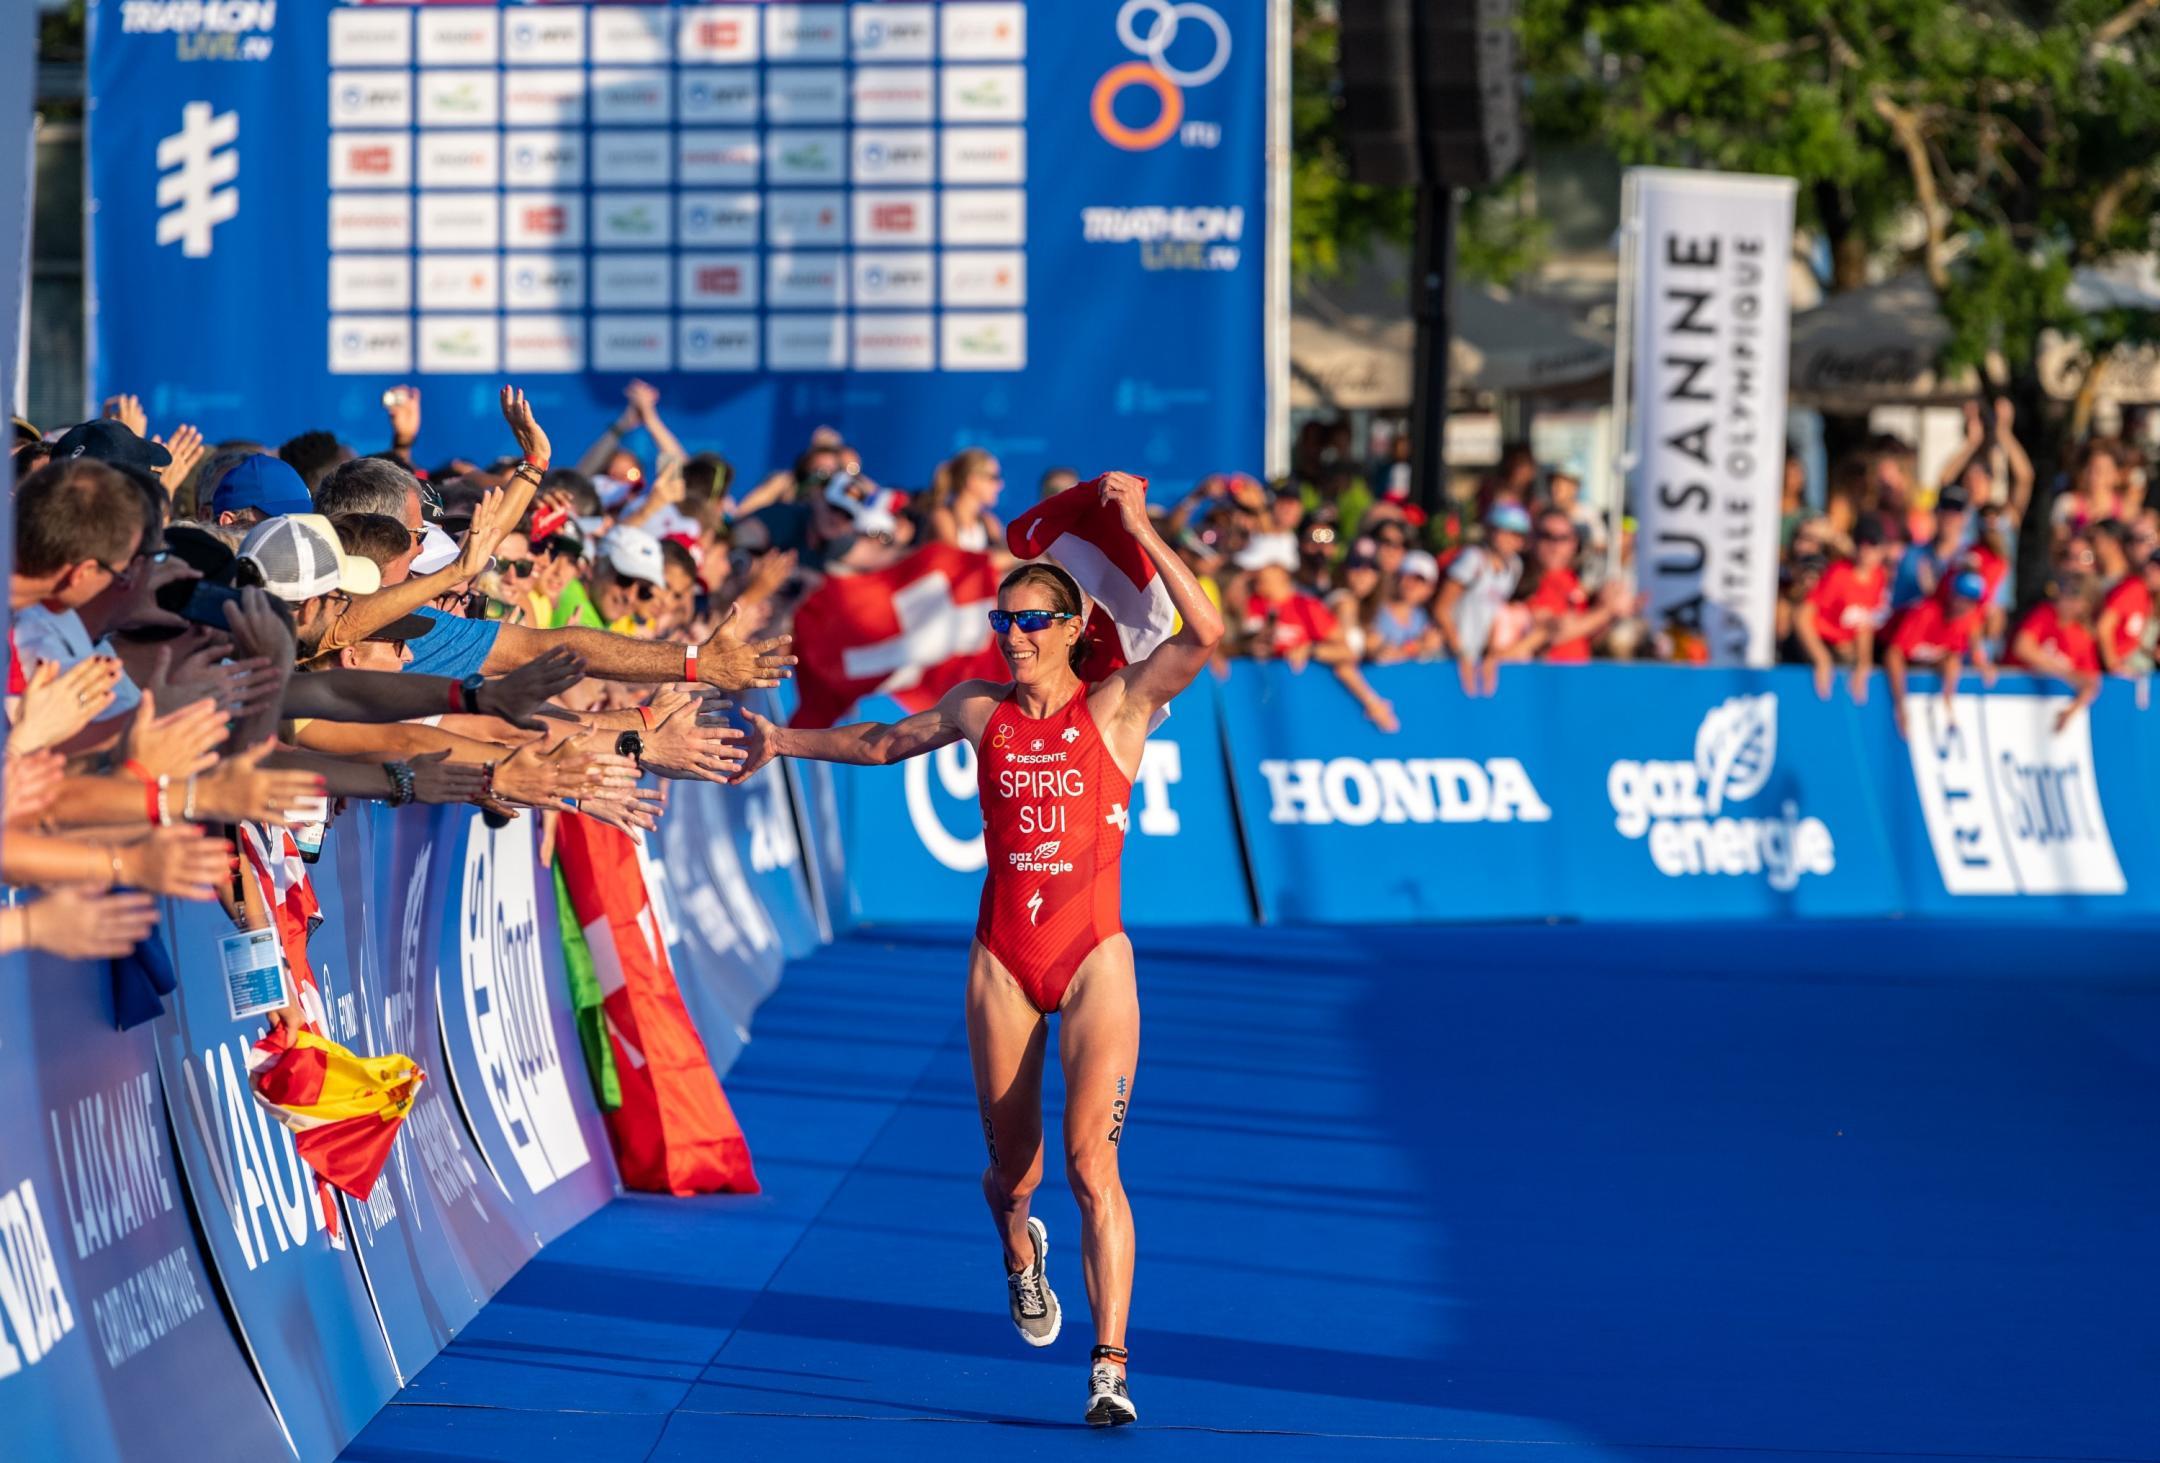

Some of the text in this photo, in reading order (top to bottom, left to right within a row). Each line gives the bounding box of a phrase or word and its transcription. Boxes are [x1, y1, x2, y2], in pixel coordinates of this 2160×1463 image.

[1081, 205, 1245, 243] TRIATHLON
[1656, 232, 1720, 634] AUSANNE
[1000, 769, 1084, 798] SPIRIG
[1016, 752, 1067, 764] DESCENTE
[1259, 757, 1552, 826] HONDA
[1019, 805, 1066, 834] SUI
[1607, 758, 1705, 839] gaz
[2001, 750, 2096, 846] Sport
[1009, 852, 1033, 864] gaz
[1016, 860, 1073, 875] energie
[1650, 800, 1835, 891] energie
[496, 899, 557, 1096] Sport
[182, 1026, 327, 1271] VAU
[1107, 1099, 1126, 1147] 34
[51, 1072, 172, 1259] LAUSANNE
[0, 1178, 75, 1379] NDA
